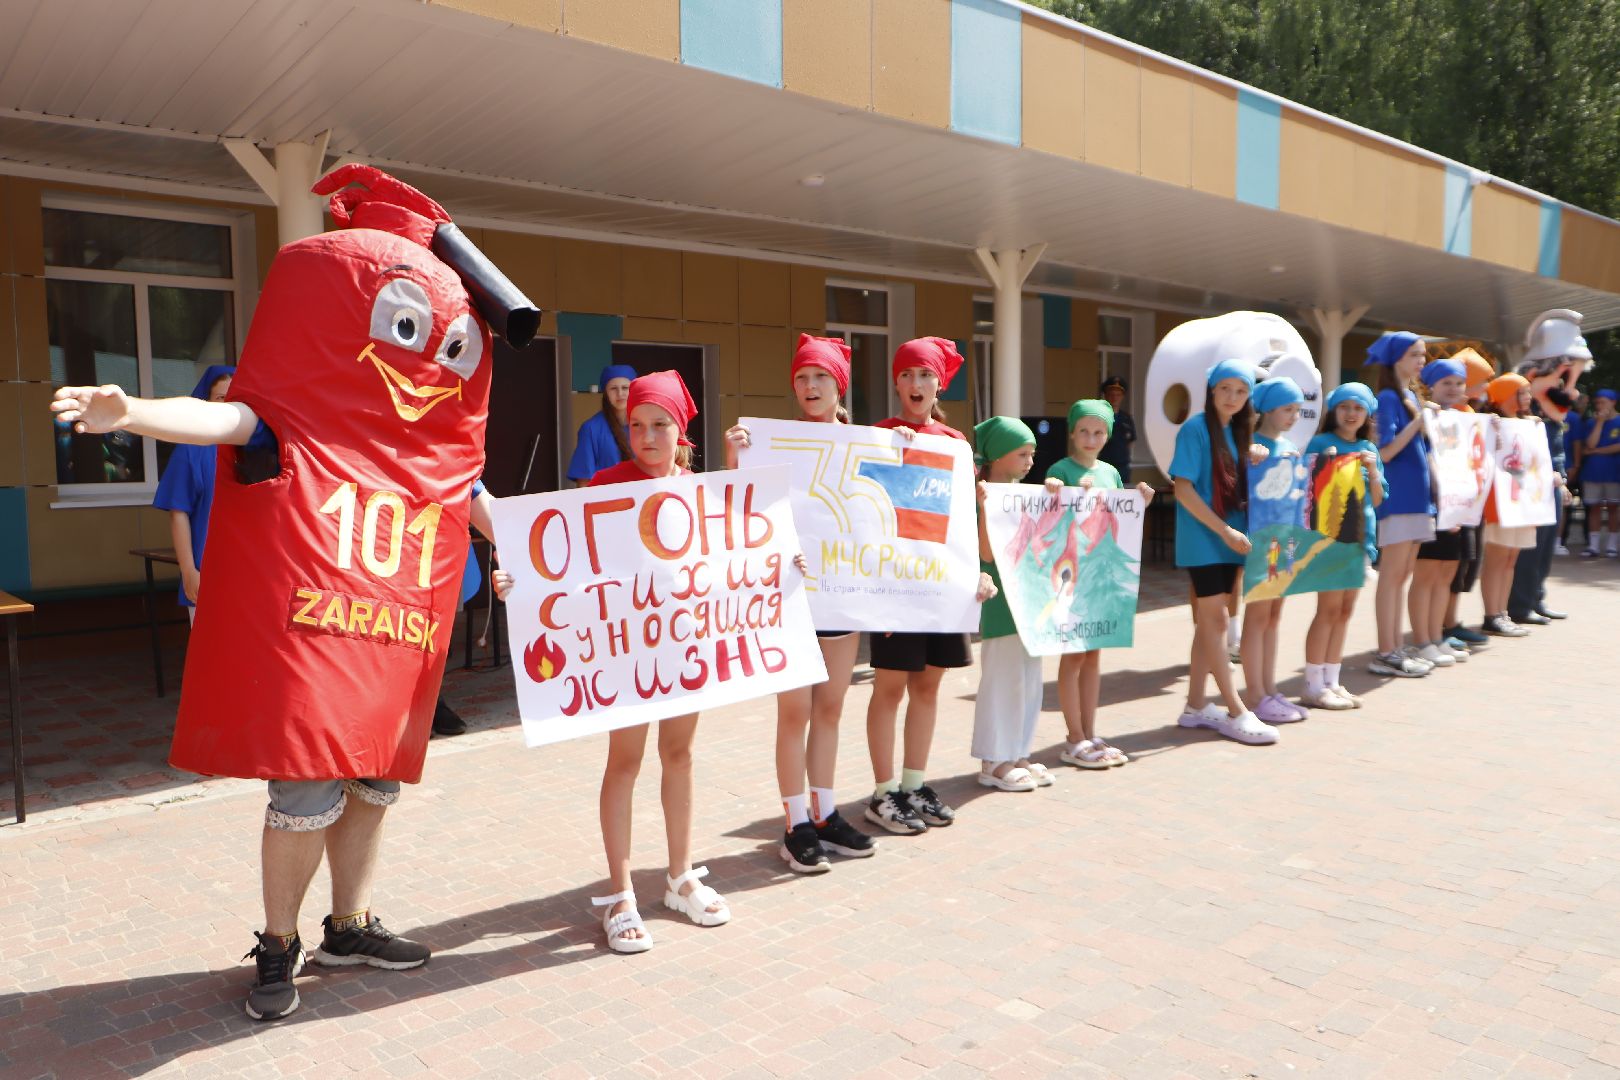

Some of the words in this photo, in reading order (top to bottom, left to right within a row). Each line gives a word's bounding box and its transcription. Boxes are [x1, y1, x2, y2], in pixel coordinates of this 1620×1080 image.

[770, 437, 903, 538] 35
[1002, 495, 1059, 514] СПИЧКИ
[319, 482, 443, 588] 101
[528, 483, 774, 581] ОГОНЬ
[821, 540, 872, 577] МЧС
[292, 589, 440, 653] ZARAISK
